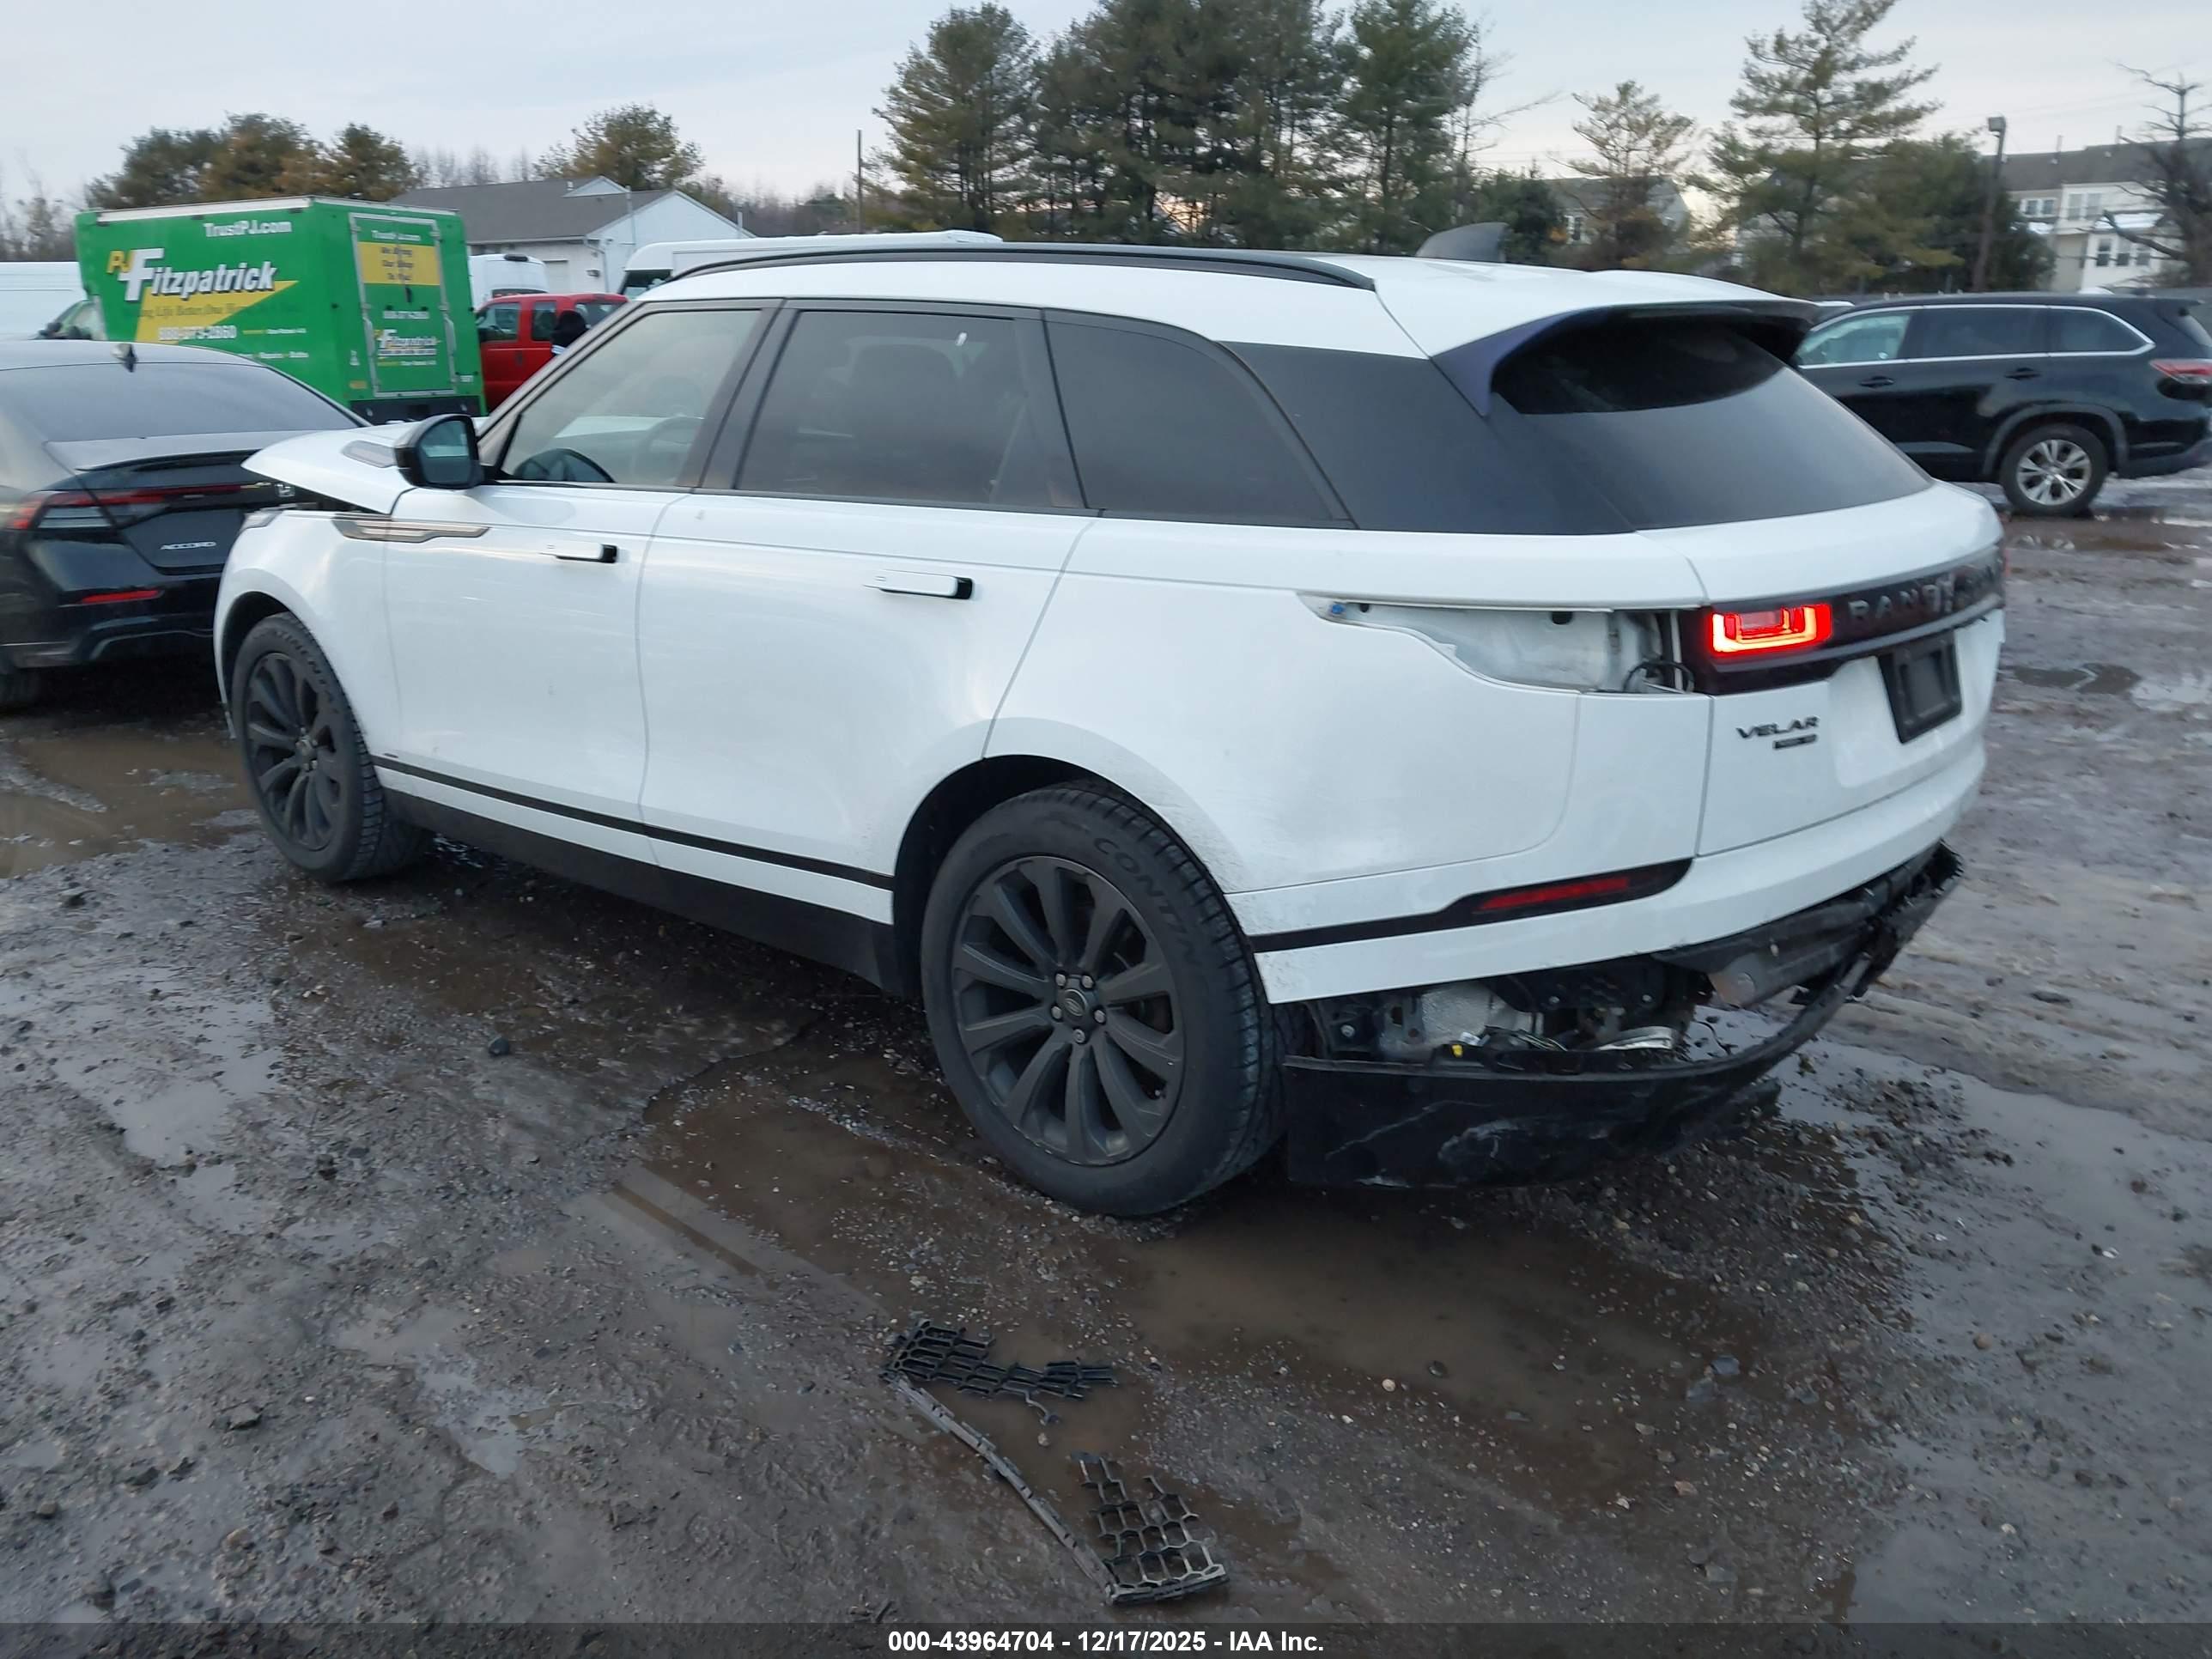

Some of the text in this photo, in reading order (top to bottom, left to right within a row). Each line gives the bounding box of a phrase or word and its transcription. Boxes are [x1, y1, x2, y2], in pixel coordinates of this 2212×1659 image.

[204, 220, 292, 237] TrustPJ.com
[118, 247, 277, 302] Fitzpatrick
[1735, 716, 1819, 738] VELAR
